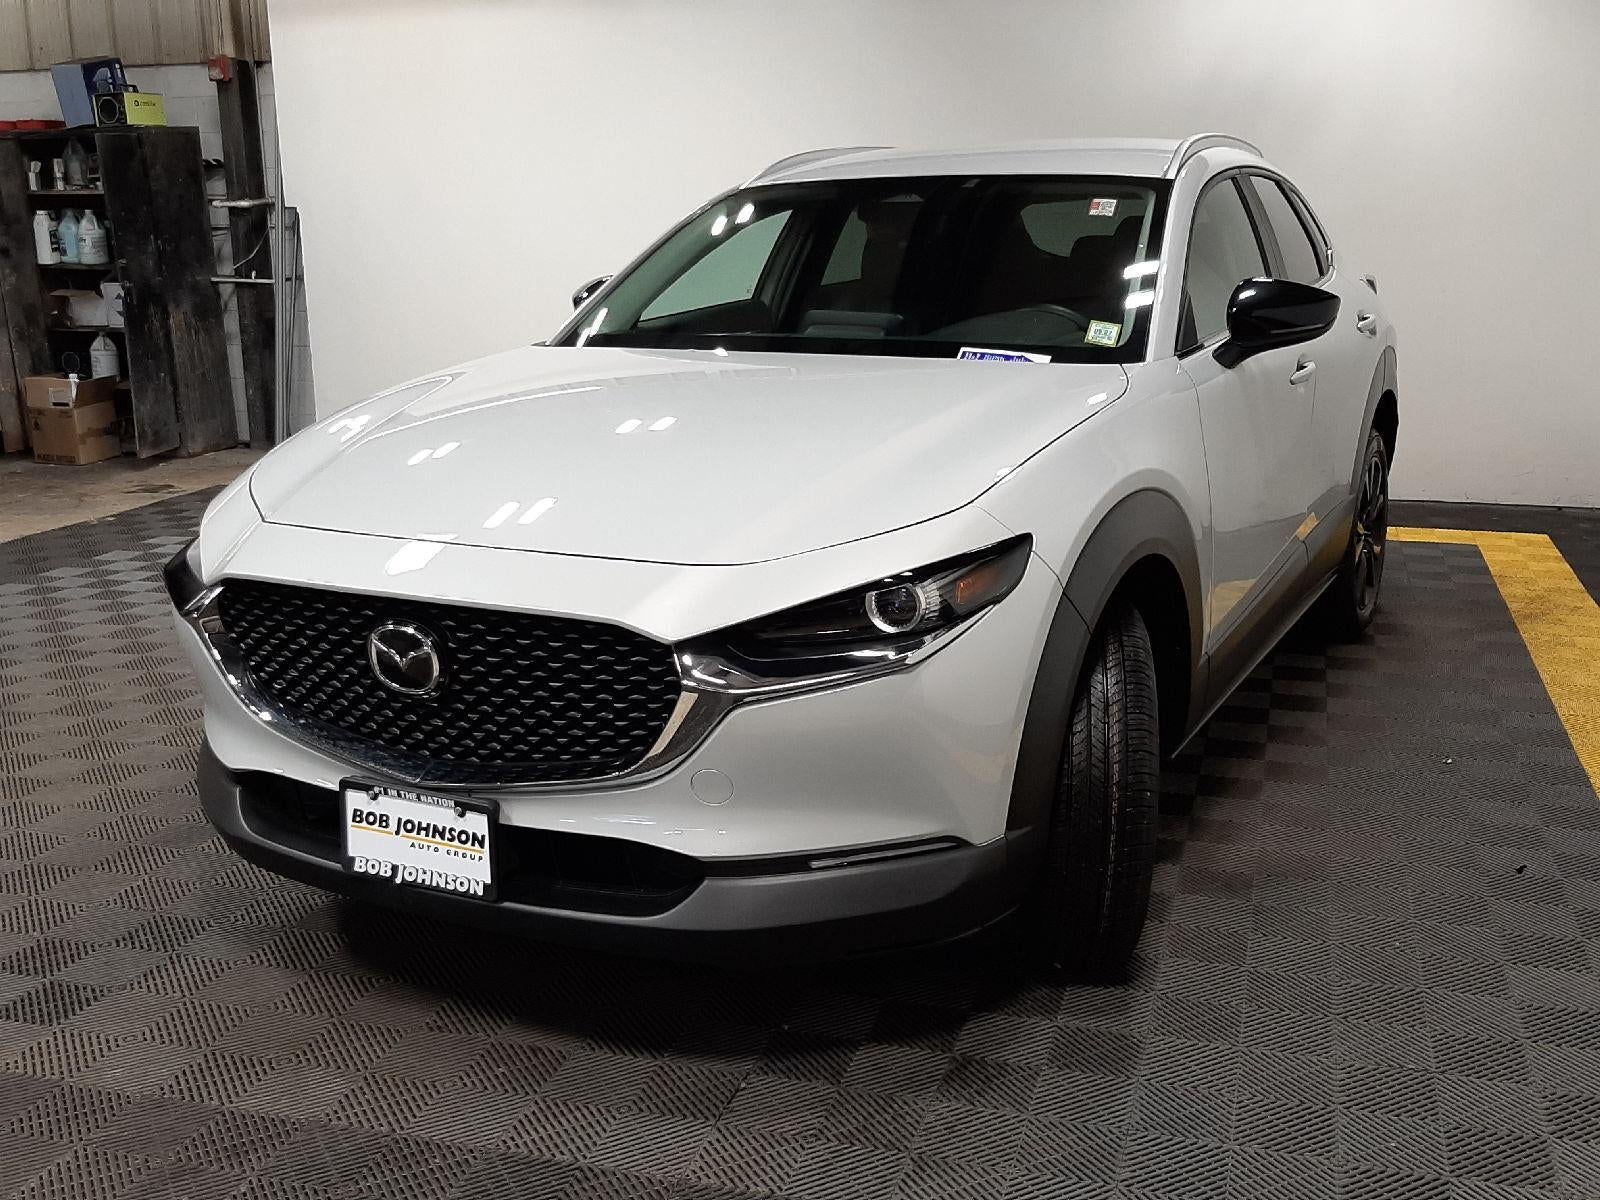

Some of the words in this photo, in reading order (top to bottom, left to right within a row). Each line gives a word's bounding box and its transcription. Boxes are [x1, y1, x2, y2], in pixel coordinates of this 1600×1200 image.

[387, 788, 398, 797] IN
[400, 790, 419, 801] THE
[420, 794, 456, 808] NATION
[352, 808, 390, 829] BOB
[395, 817, 486, 849] JOHNSON
[410, 841, 440, 853] AUTO
[446, 848, 484, 862] GROUP
[353, 856, 393, 877] BOB
[395, 863, 485, 896] JOHNSON
